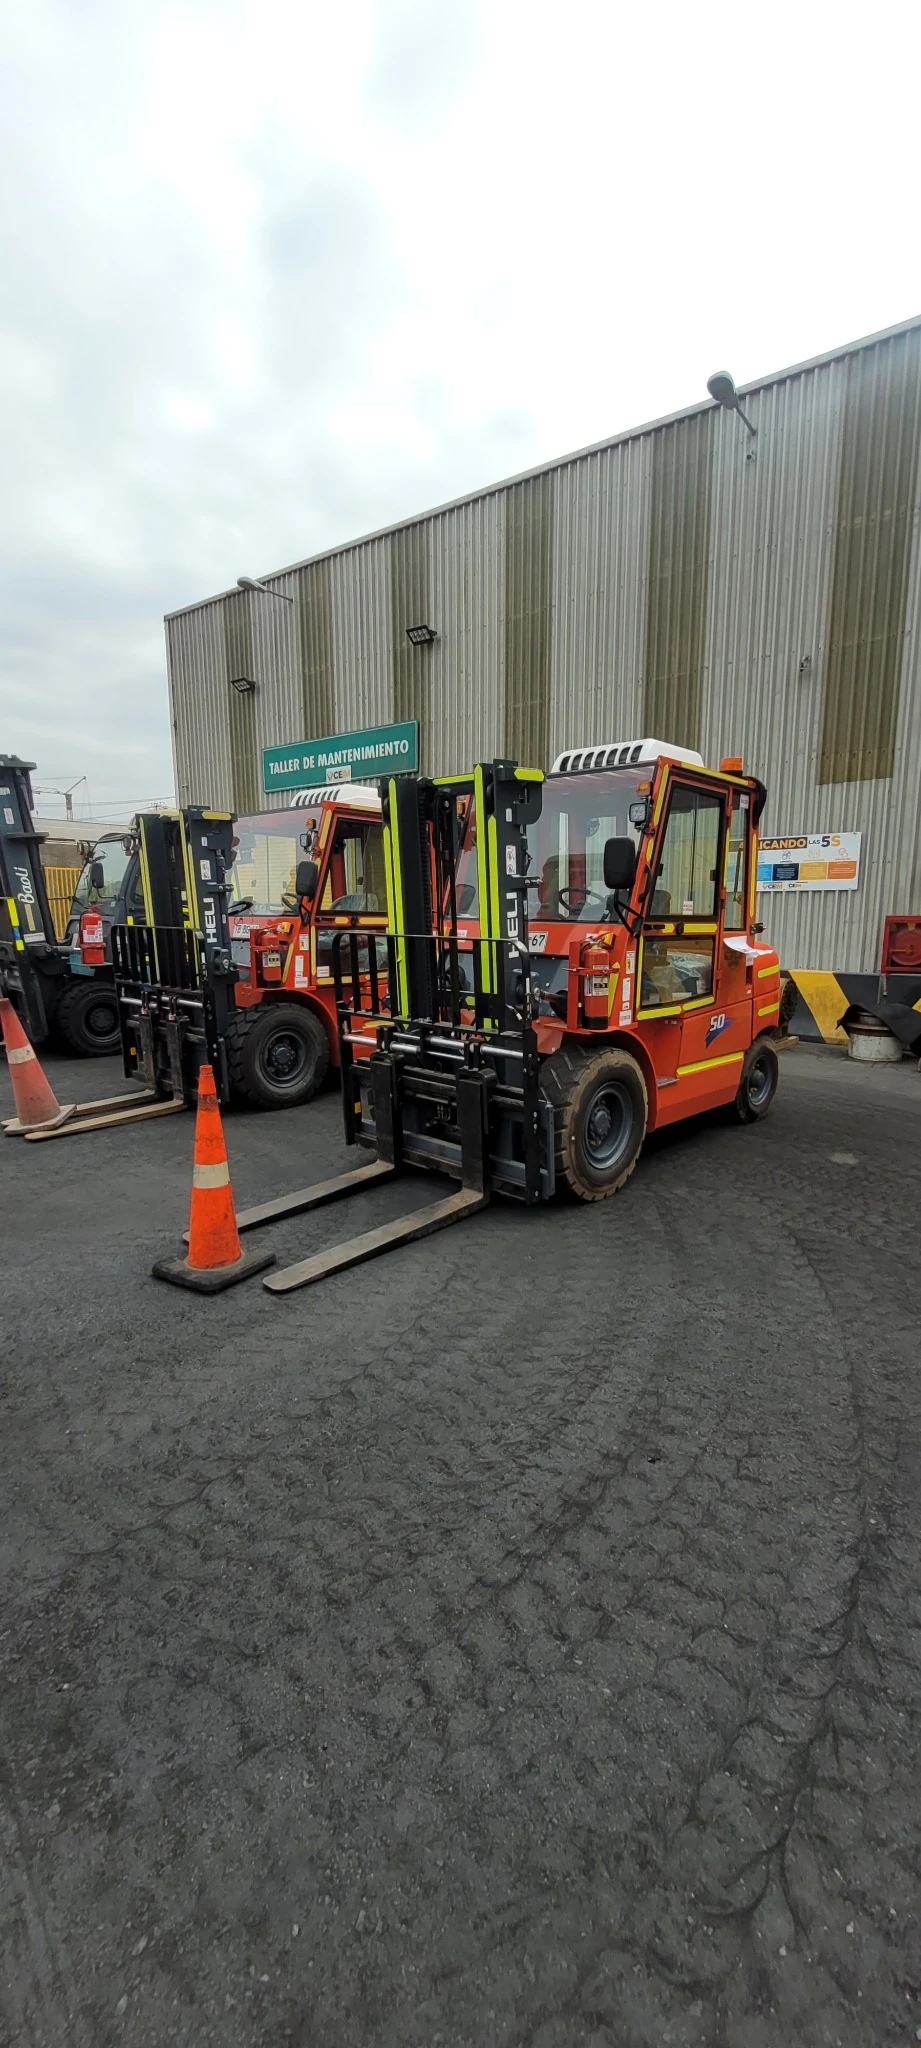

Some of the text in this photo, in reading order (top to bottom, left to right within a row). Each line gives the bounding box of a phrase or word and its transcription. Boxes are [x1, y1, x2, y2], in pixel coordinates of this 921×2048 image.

[269, 740, 410, 775] TALLER DE MANTENIMIENTO
[821, 835, 841, 848] 5S
[14, 867, 35, 904] Baoli
[203, 897, 218, 944] HELI
[506, 892, 520, 958] HELI
[710, 1013, 726, 1032] 50
